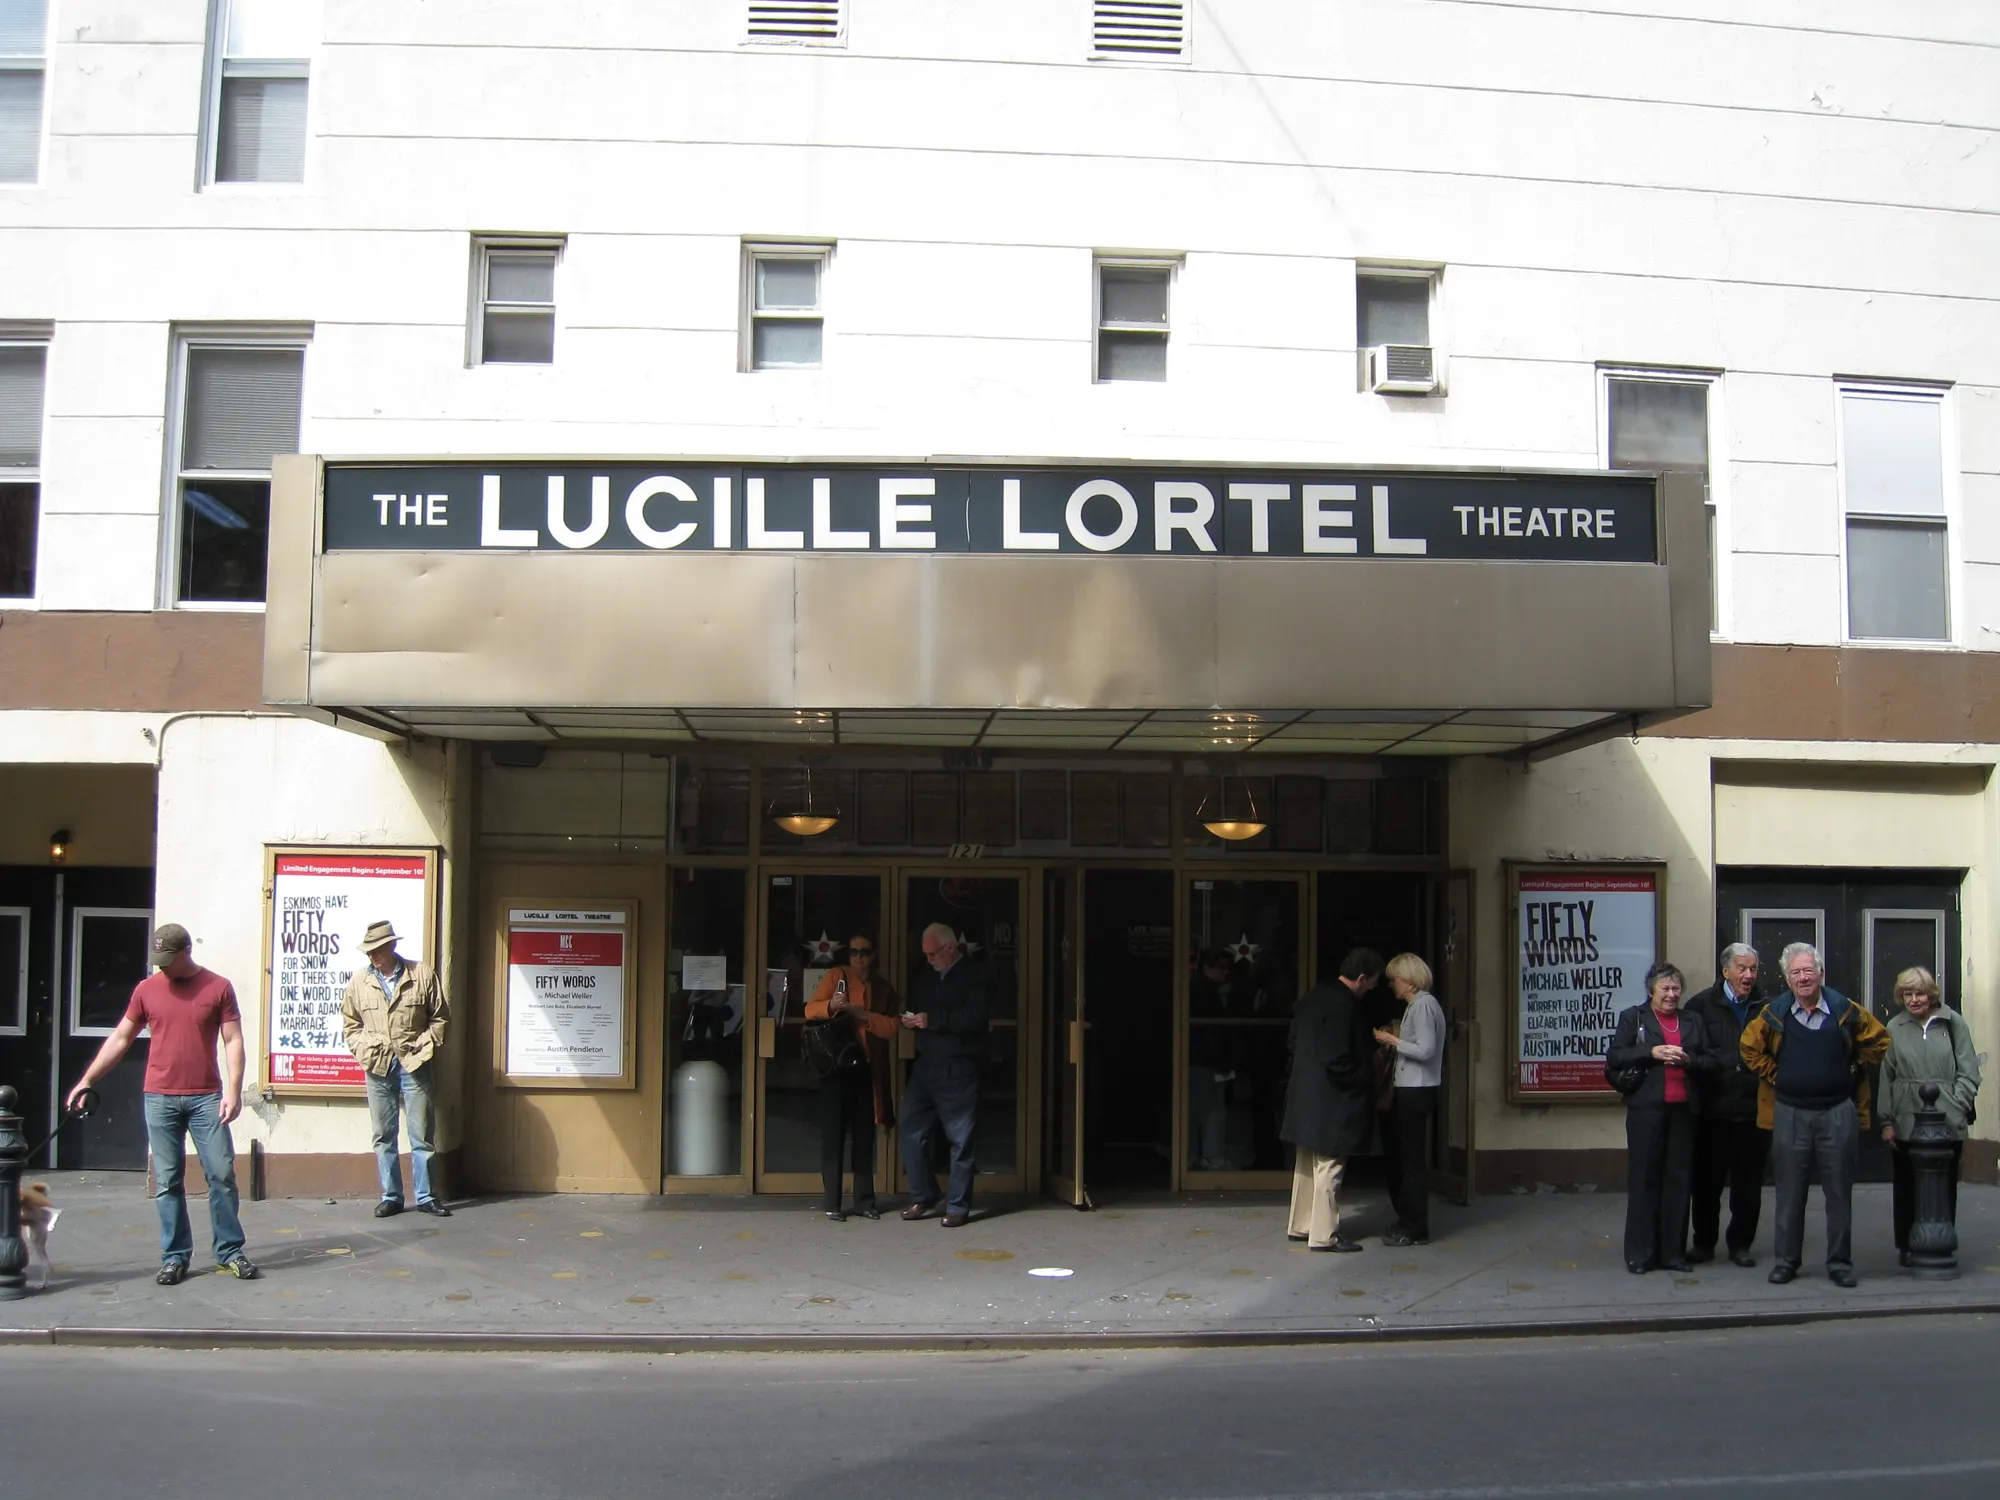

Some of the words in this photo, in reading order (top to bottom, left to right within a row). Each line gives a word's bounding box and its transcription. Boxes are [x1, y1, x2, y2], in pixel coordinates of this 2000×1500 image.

[373, 494, 448, 526] THE
[481, 475, 936, 549] LUCILLE
[1003, 479, 1427, 554] LORTEL
[1453, 505, 1616, 538] THEATRE
[952, 845, 980, 858] 121
[309, 866, 351, 874] Engagement
[352, 866, 374, 874] Begins
[375, 867, 412, 876] September
[1546, 881, 1584, 889] Engagement
[283, 896, 321, 910] ESKIMOS
[325, 895, 348, 908] HAVE
[283, 910, 325, 934] FIFTY
[1526, 900, 1594, 942] FIFTY
[281, 932, 340, 955] WORDS
[560, 934, 572, 948] MCC
[1524, 935, 1599, 968] WORDS
[283, 957, 298, 970] FOR
[281, 972, 298, 984] BUT
[302, 972, 336, 984] THERE'S
[536, 976, 559, 989] FIFTY
[562, 976, 596, 988] WORDS
[1522, 972, 1570, 991] MICHAEL
[1570, 966, 1622, 990] WELLER
[280, 986, 299, 1001] ONE
[302, 986, 331, 1001] WORD
[280, 1002, 294, 1015] JAN
[298, 1002, 314, 1015] AND
[1528, 1000, 1562, 1014] NORBERT
[1566, 998, 1579, 1012] LEO
[1582, 992, 1612, 1012] BUTZ
[280, 1017, 328, 1030] MARRIAGE:
[1528, 1015, 1568, 1030] ELIZABETH
[1571, 1012, 1617, 1032] MARVEL
[1523, 1040, 1561, 1057] AUSTIN
[274, 1055, 295, 1076] MCC
[1520, 1064, 1538, 1084] MCC
